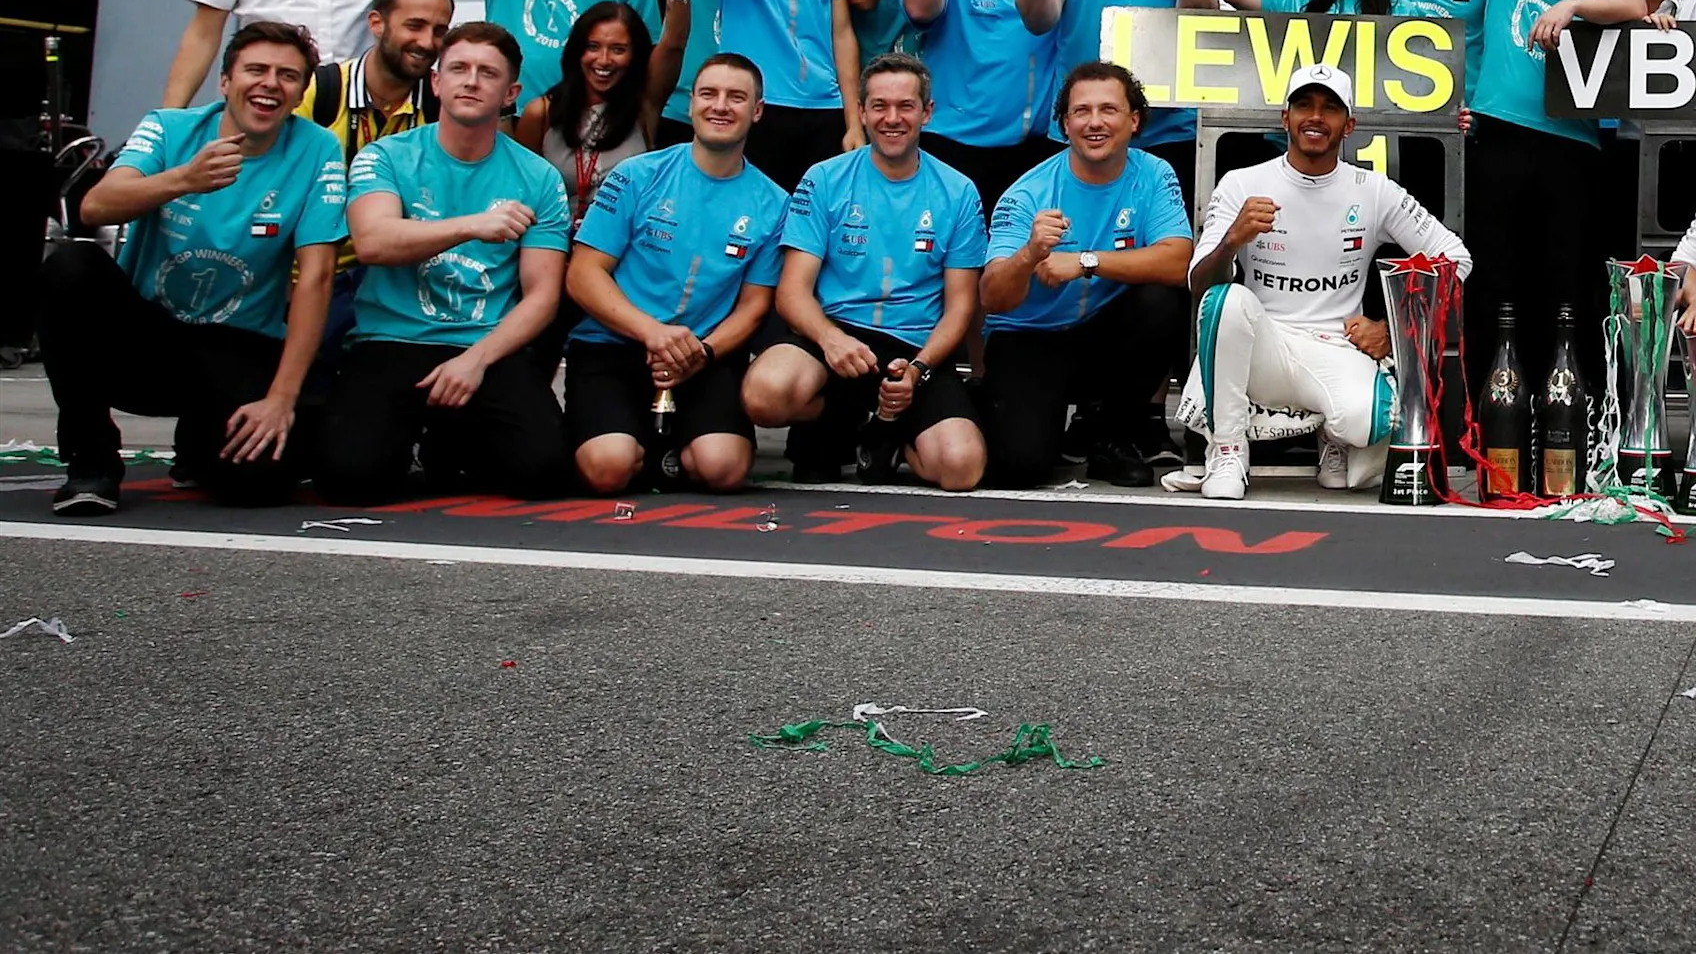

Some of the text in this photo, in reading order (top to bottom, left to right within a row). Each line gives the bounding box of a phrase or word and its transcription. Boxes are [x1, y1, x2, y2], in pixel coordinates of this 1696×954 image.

[1112, 13, 1455, 113] LEWIS
[1557, 28, 1696, 109] VB
[1253, 268, 1360, 294] PETRONAS
[1266, 241, 1286, 252] UBS
[110, 476, 1327, 554] MILTON
